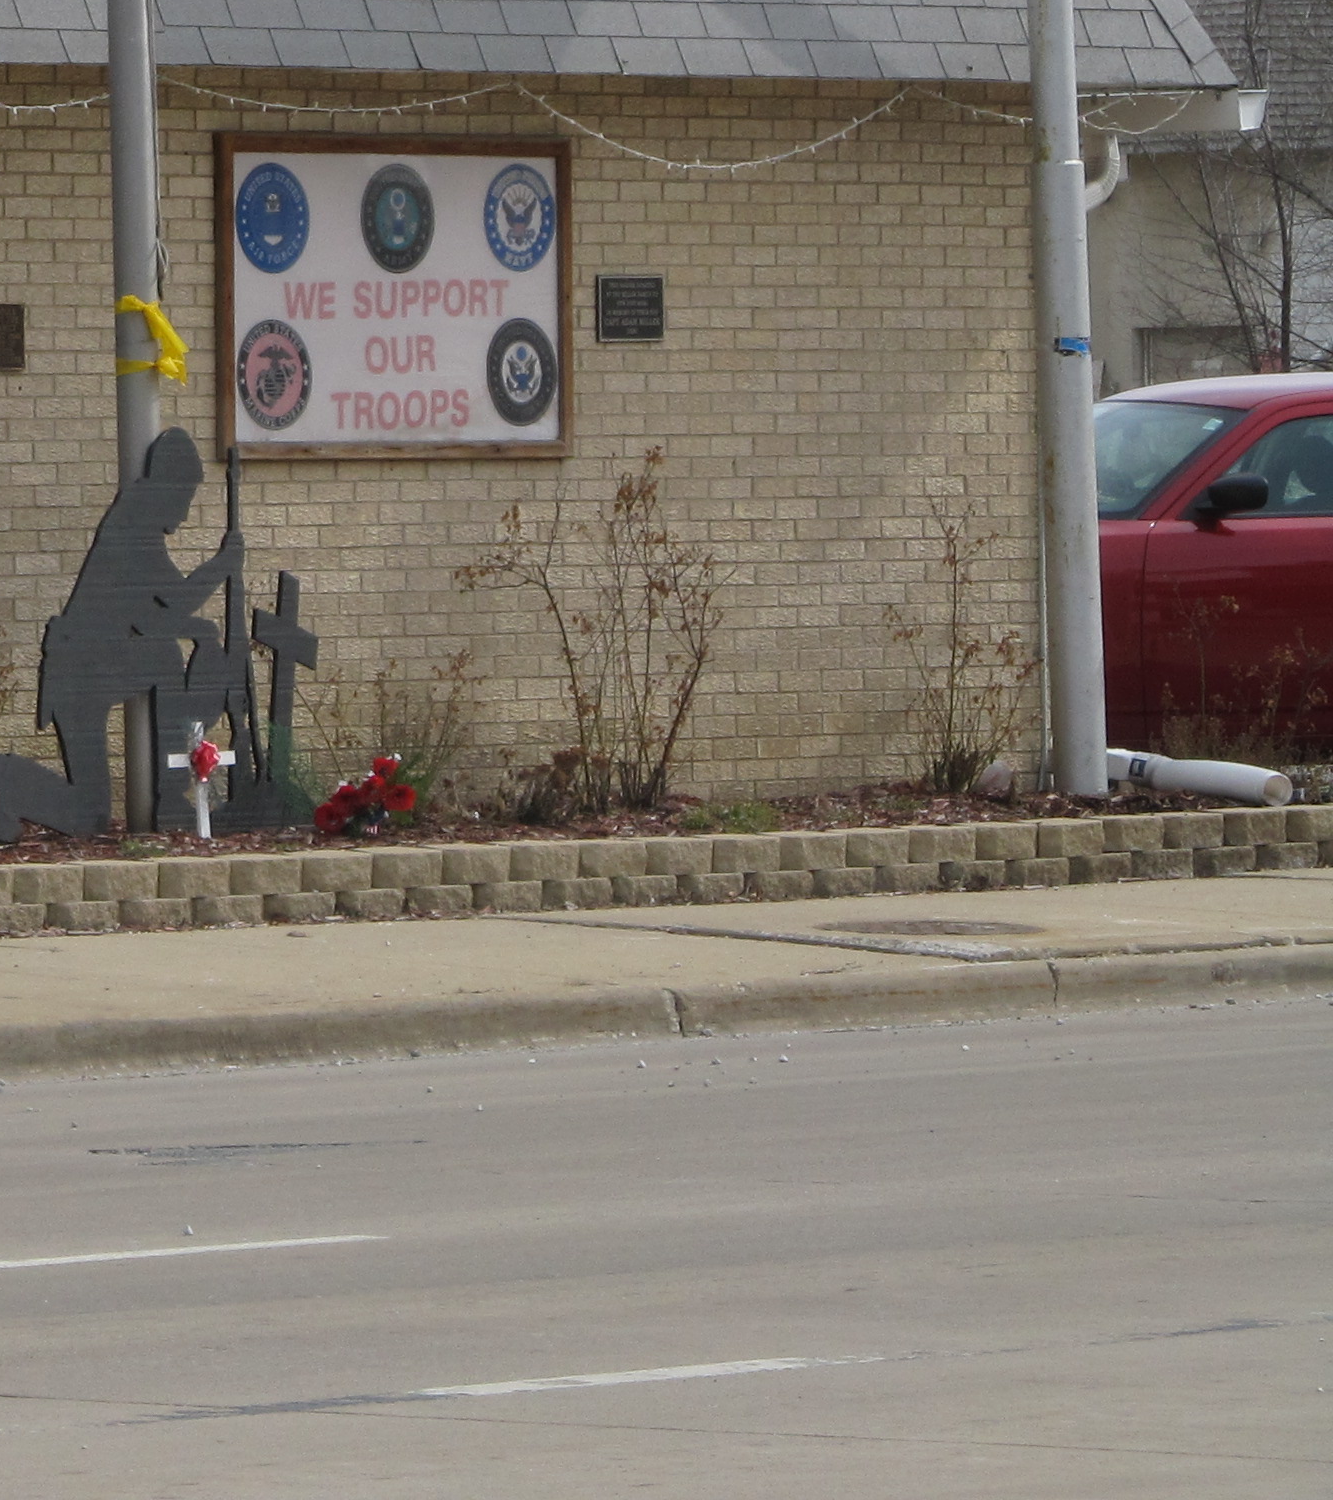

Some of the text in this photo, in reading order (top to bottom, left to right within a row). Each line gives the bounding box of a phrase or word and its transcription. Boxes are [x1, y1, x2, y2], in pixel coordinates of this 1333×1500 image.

[284, 279, 510, 319] WE SUPPORT
[364, 335, 436, 374] OUR
[331, 389, 470, 430] TROOPS
